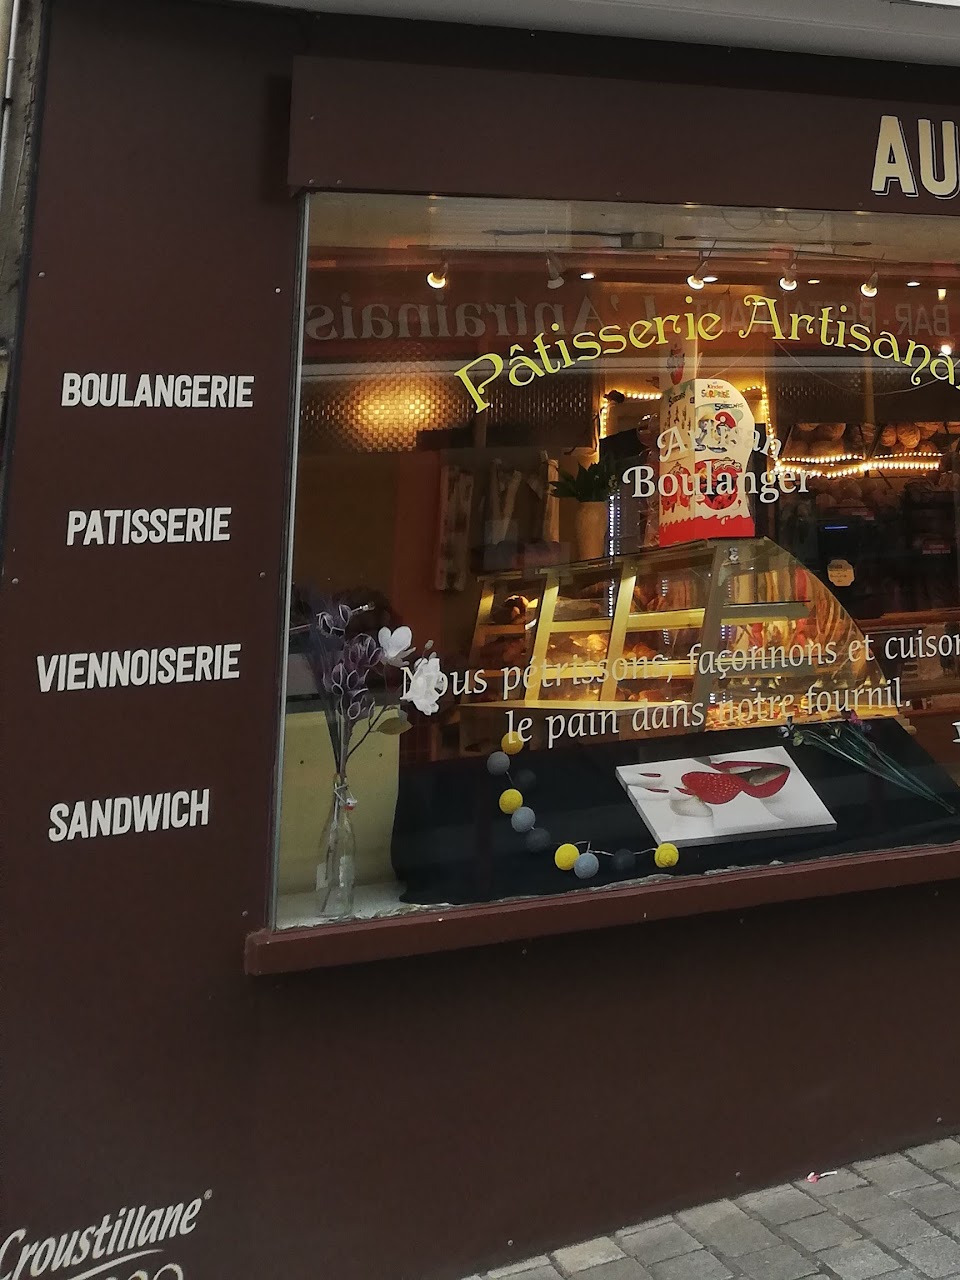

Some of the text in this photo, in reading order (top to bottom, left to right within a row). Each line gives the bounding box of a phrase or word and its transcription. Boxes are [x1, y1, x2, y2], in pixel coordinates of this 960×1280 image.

[871, 115, 960, 199] AU
[454, 296, 724, 415] Pâtisserie
[61, 372, 255, 409] BOULANGERIE
[622, 461, 813, 504] Boulanger
[66, 507, 232, 547] PATISSERIE
[36, 644, 242, 693] VIENNOISERIE
[501, 653, 675, 701] pétrissons,
[687, 638, 837, 680] façonnons
[848, 634, 875, 662] et
[505, 676, 912, 749] le pain dans notre fournil.
[48, 789, 210, 843] SANDWICH
